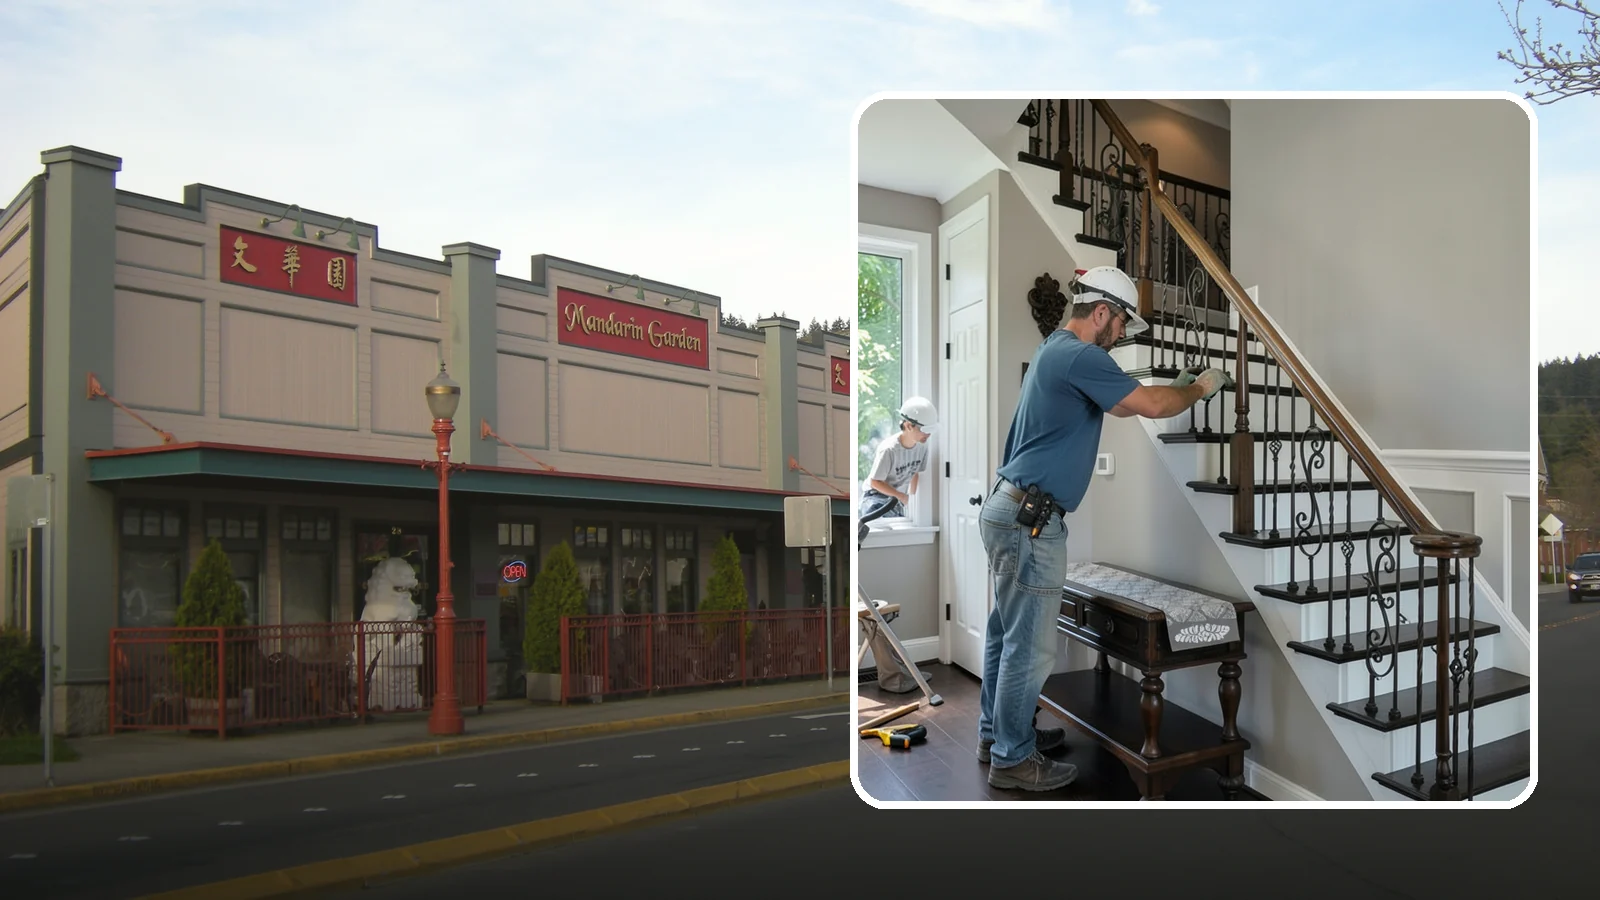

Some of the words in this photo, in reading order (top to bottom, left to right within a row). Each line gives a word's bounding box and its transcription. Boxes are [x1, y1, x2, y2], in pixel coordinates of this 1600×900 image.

[231, 235, 347, 291] 文華園
[564, 302, 644, 341] Mandarin
[648, 320, 702, 352] Garden
[503, 565, 527, 578] OPEN
